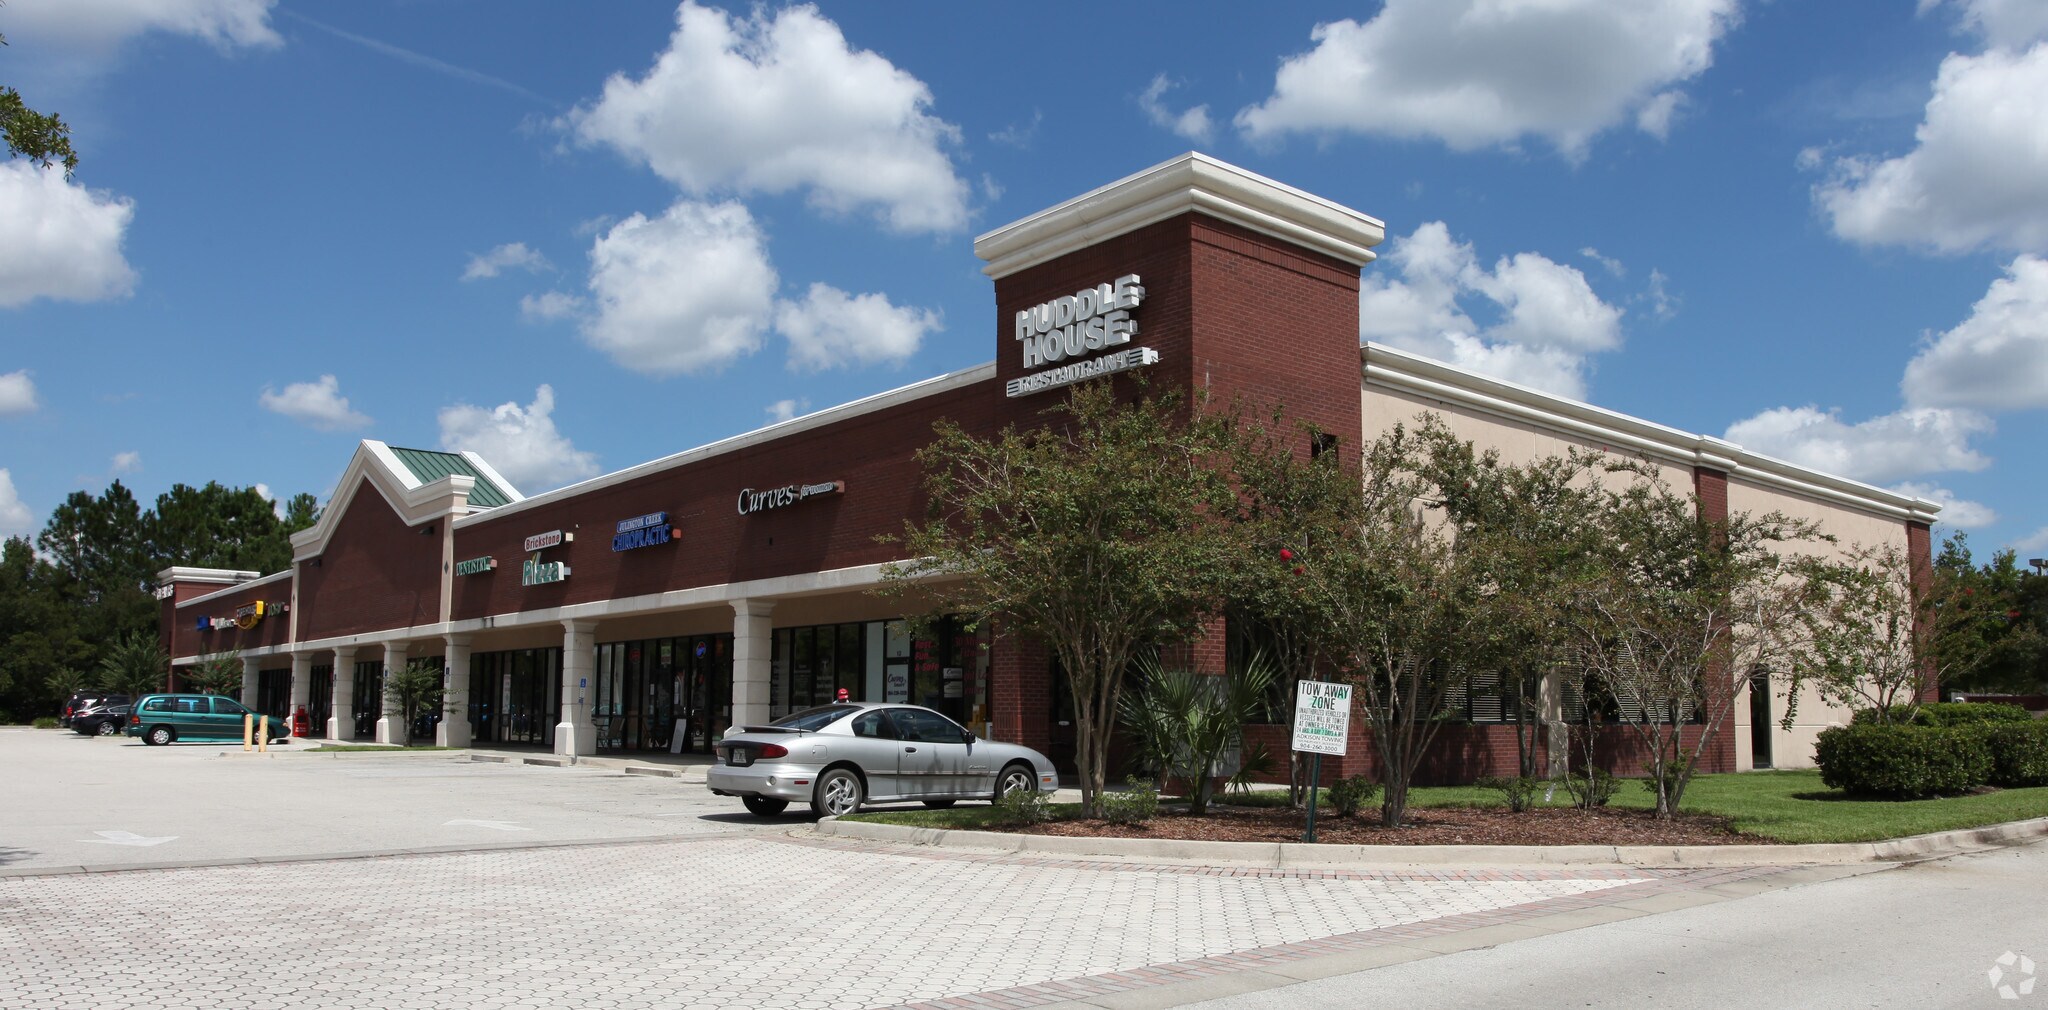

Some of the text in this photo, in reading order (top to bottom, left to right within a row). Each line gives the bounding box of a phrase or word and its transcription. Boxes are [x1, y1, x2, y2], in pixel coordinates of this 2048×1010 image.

[1016, 274, 1141, 341] HUDDLE
[1023, 310, 1131, 369] HOUSE
[1017, 351, 1130, 393] RESTAURANT
[738, 485, 794, 515] Curves
[526, 534, 560, 550] Brickstone
[612, 524, 669, 552] CHIROPRACTIC
[522, 553, 564, 586] Pizza
[1302, 682, 1349, 699] TOW AWAY
[1312, 696, 1335, 710] ZONE
